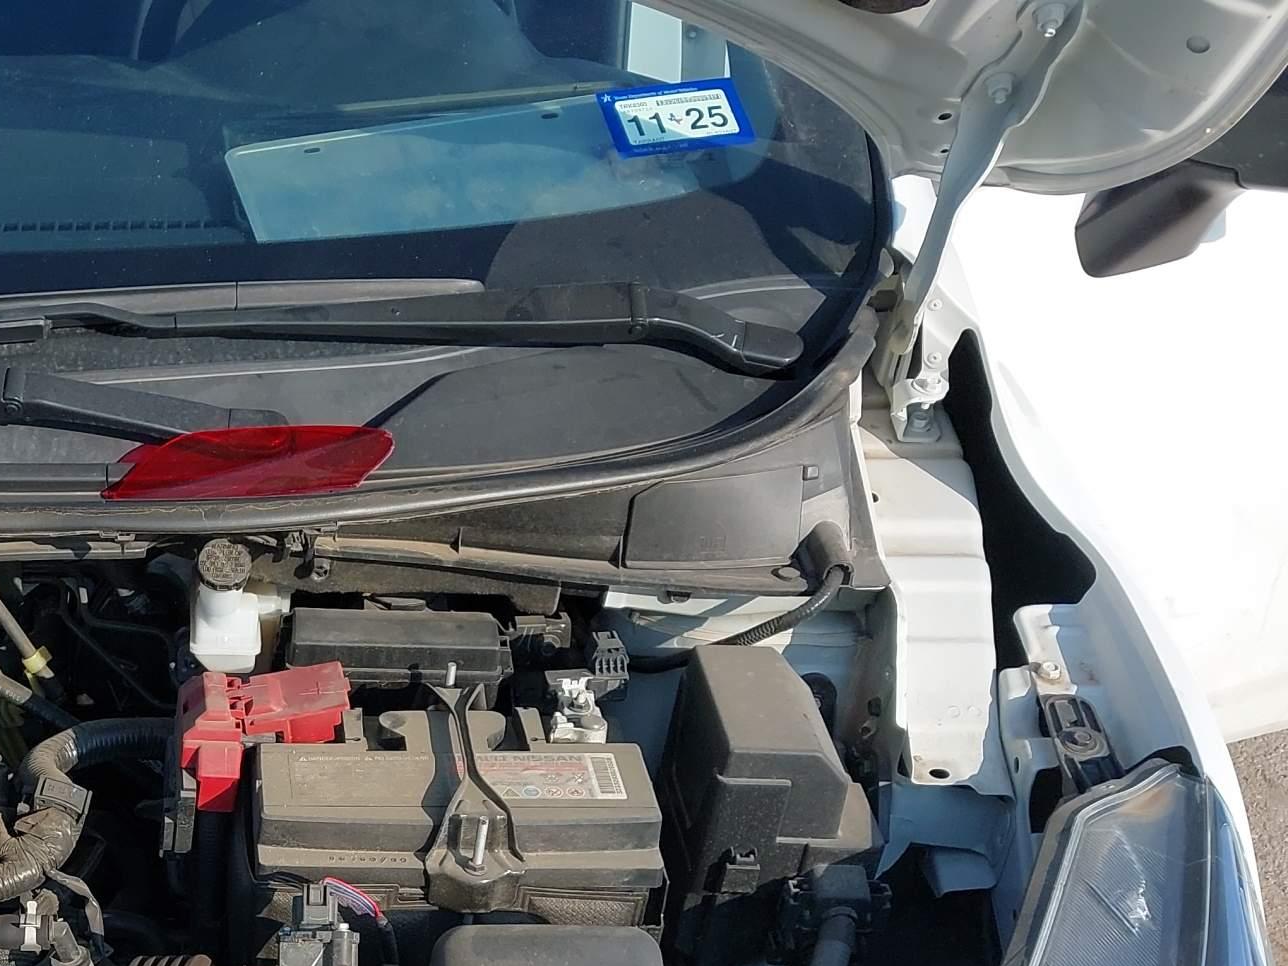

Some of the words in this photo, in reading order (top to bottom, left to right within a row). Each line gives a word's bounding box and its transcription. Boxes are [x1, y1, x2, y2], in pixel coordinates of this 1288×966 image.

[627, 112, 666, 136] 11
[685, 105, 729, 130] 25
[512, 754, 582, 762] NISSAN
